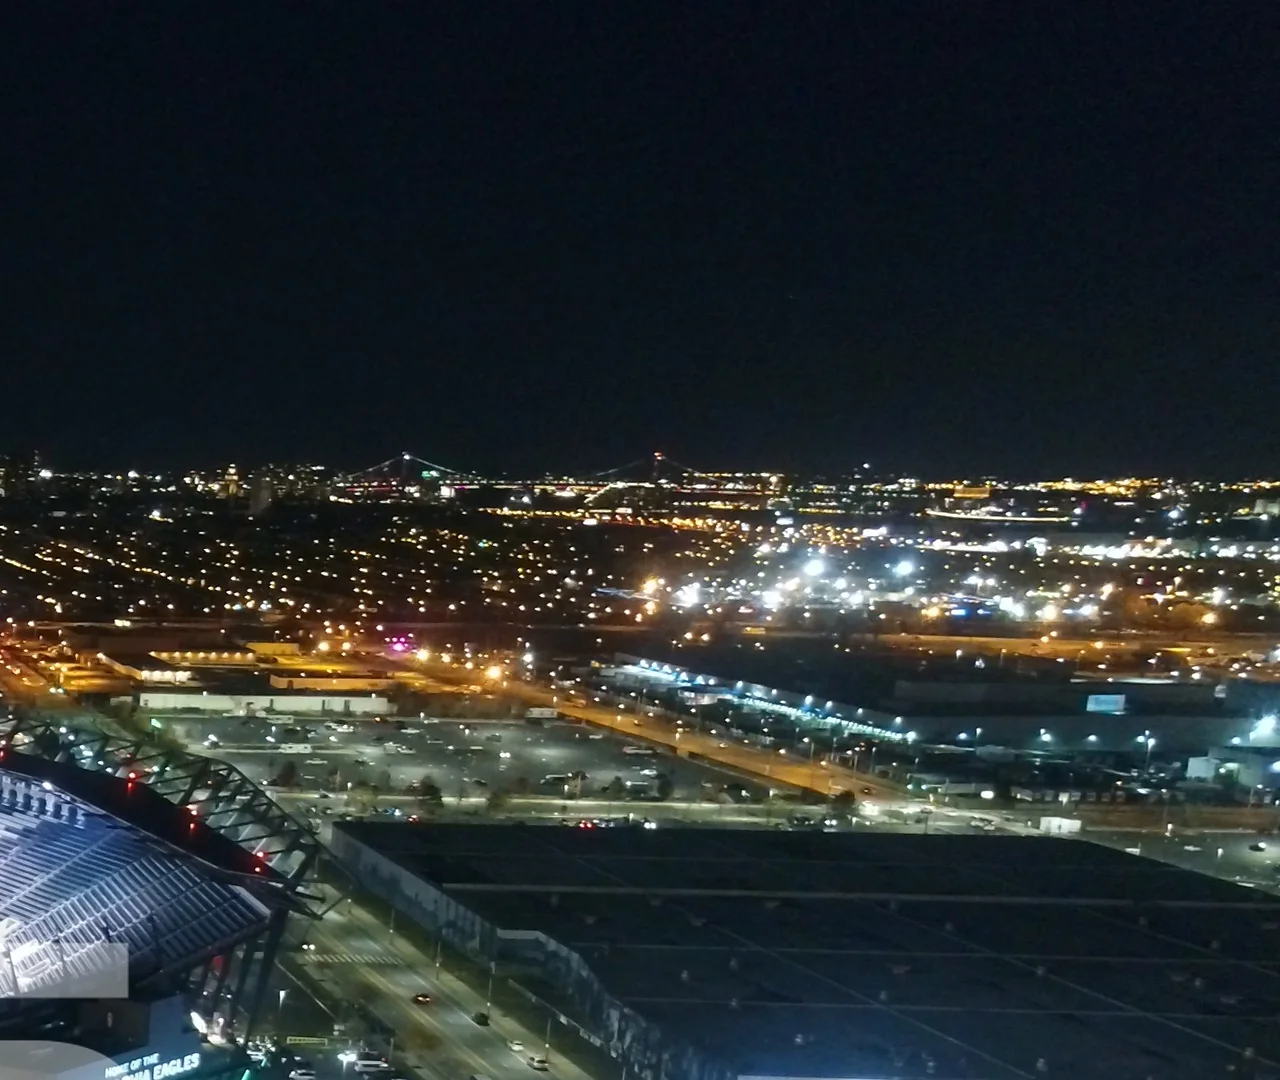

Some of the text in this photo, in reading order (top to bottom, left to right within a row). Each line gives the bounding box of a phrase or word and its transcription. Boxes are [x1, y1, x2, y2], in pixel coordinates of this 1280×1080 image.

[105, 1053, 160, 1078] HOME OF THE
[153, 1053, 200, 1080] EAGLES
